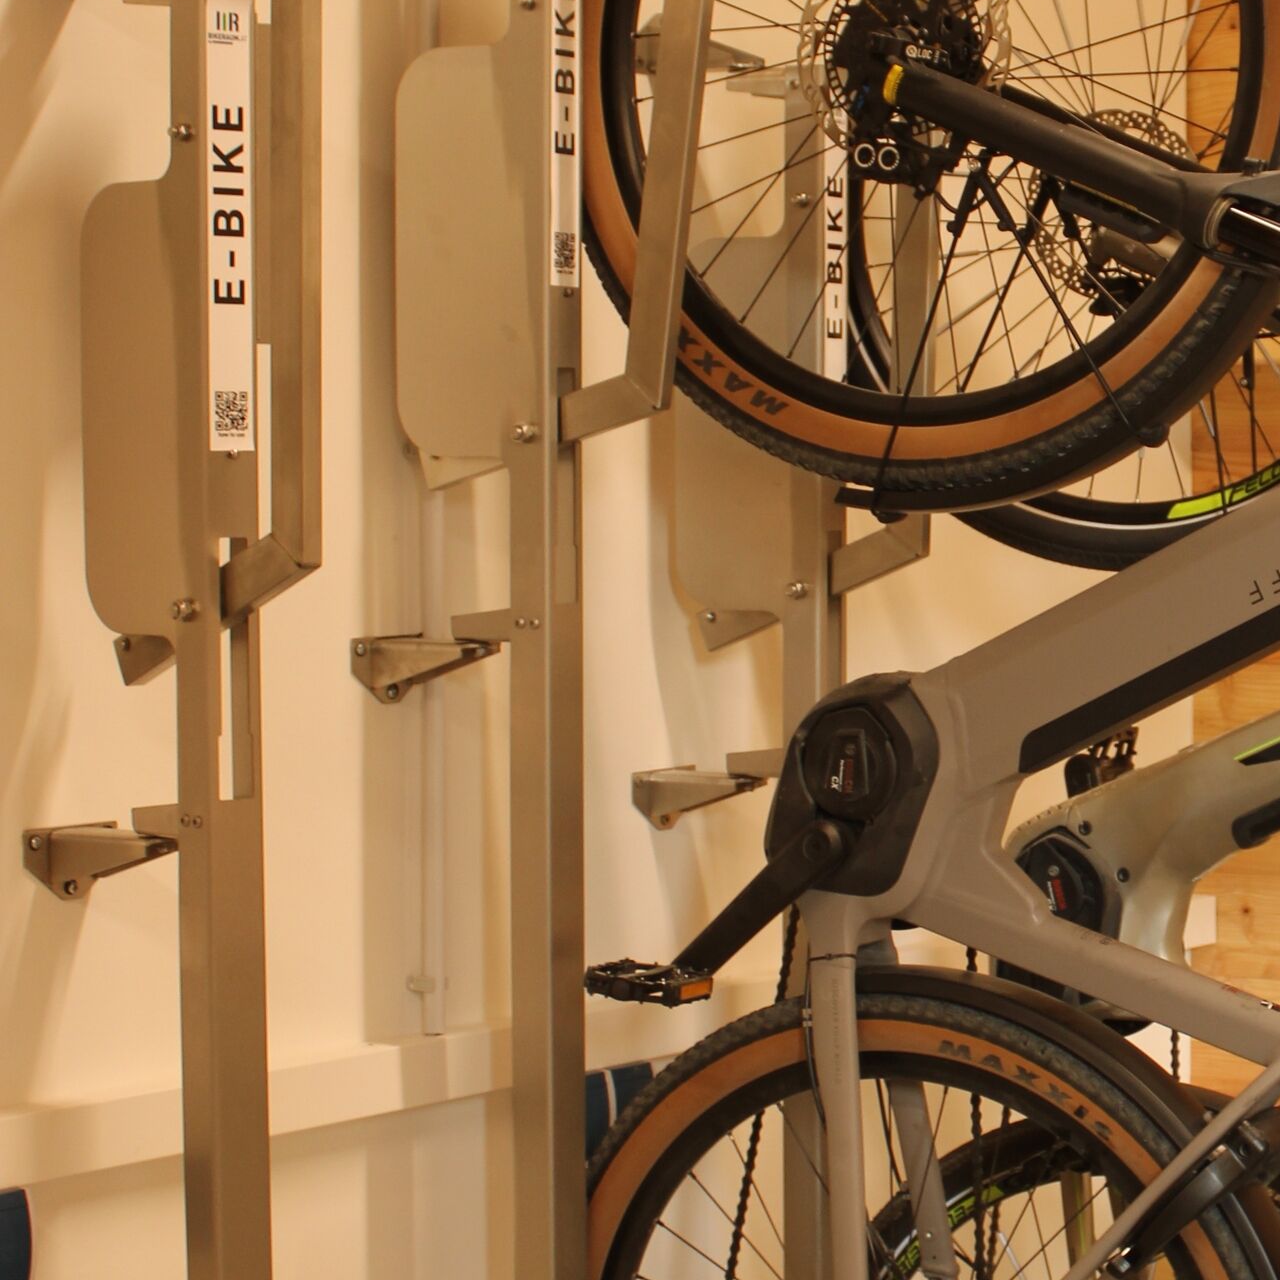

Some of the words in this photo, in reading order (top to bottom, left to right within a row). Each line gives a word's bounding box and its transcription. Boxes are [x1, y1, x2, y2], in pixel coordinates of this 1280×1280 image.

[211, 104, 246, 306] E-BIKE
[827, 176, 844, 340] E-BIKE
[677, 325, 790, 416] MAXX
